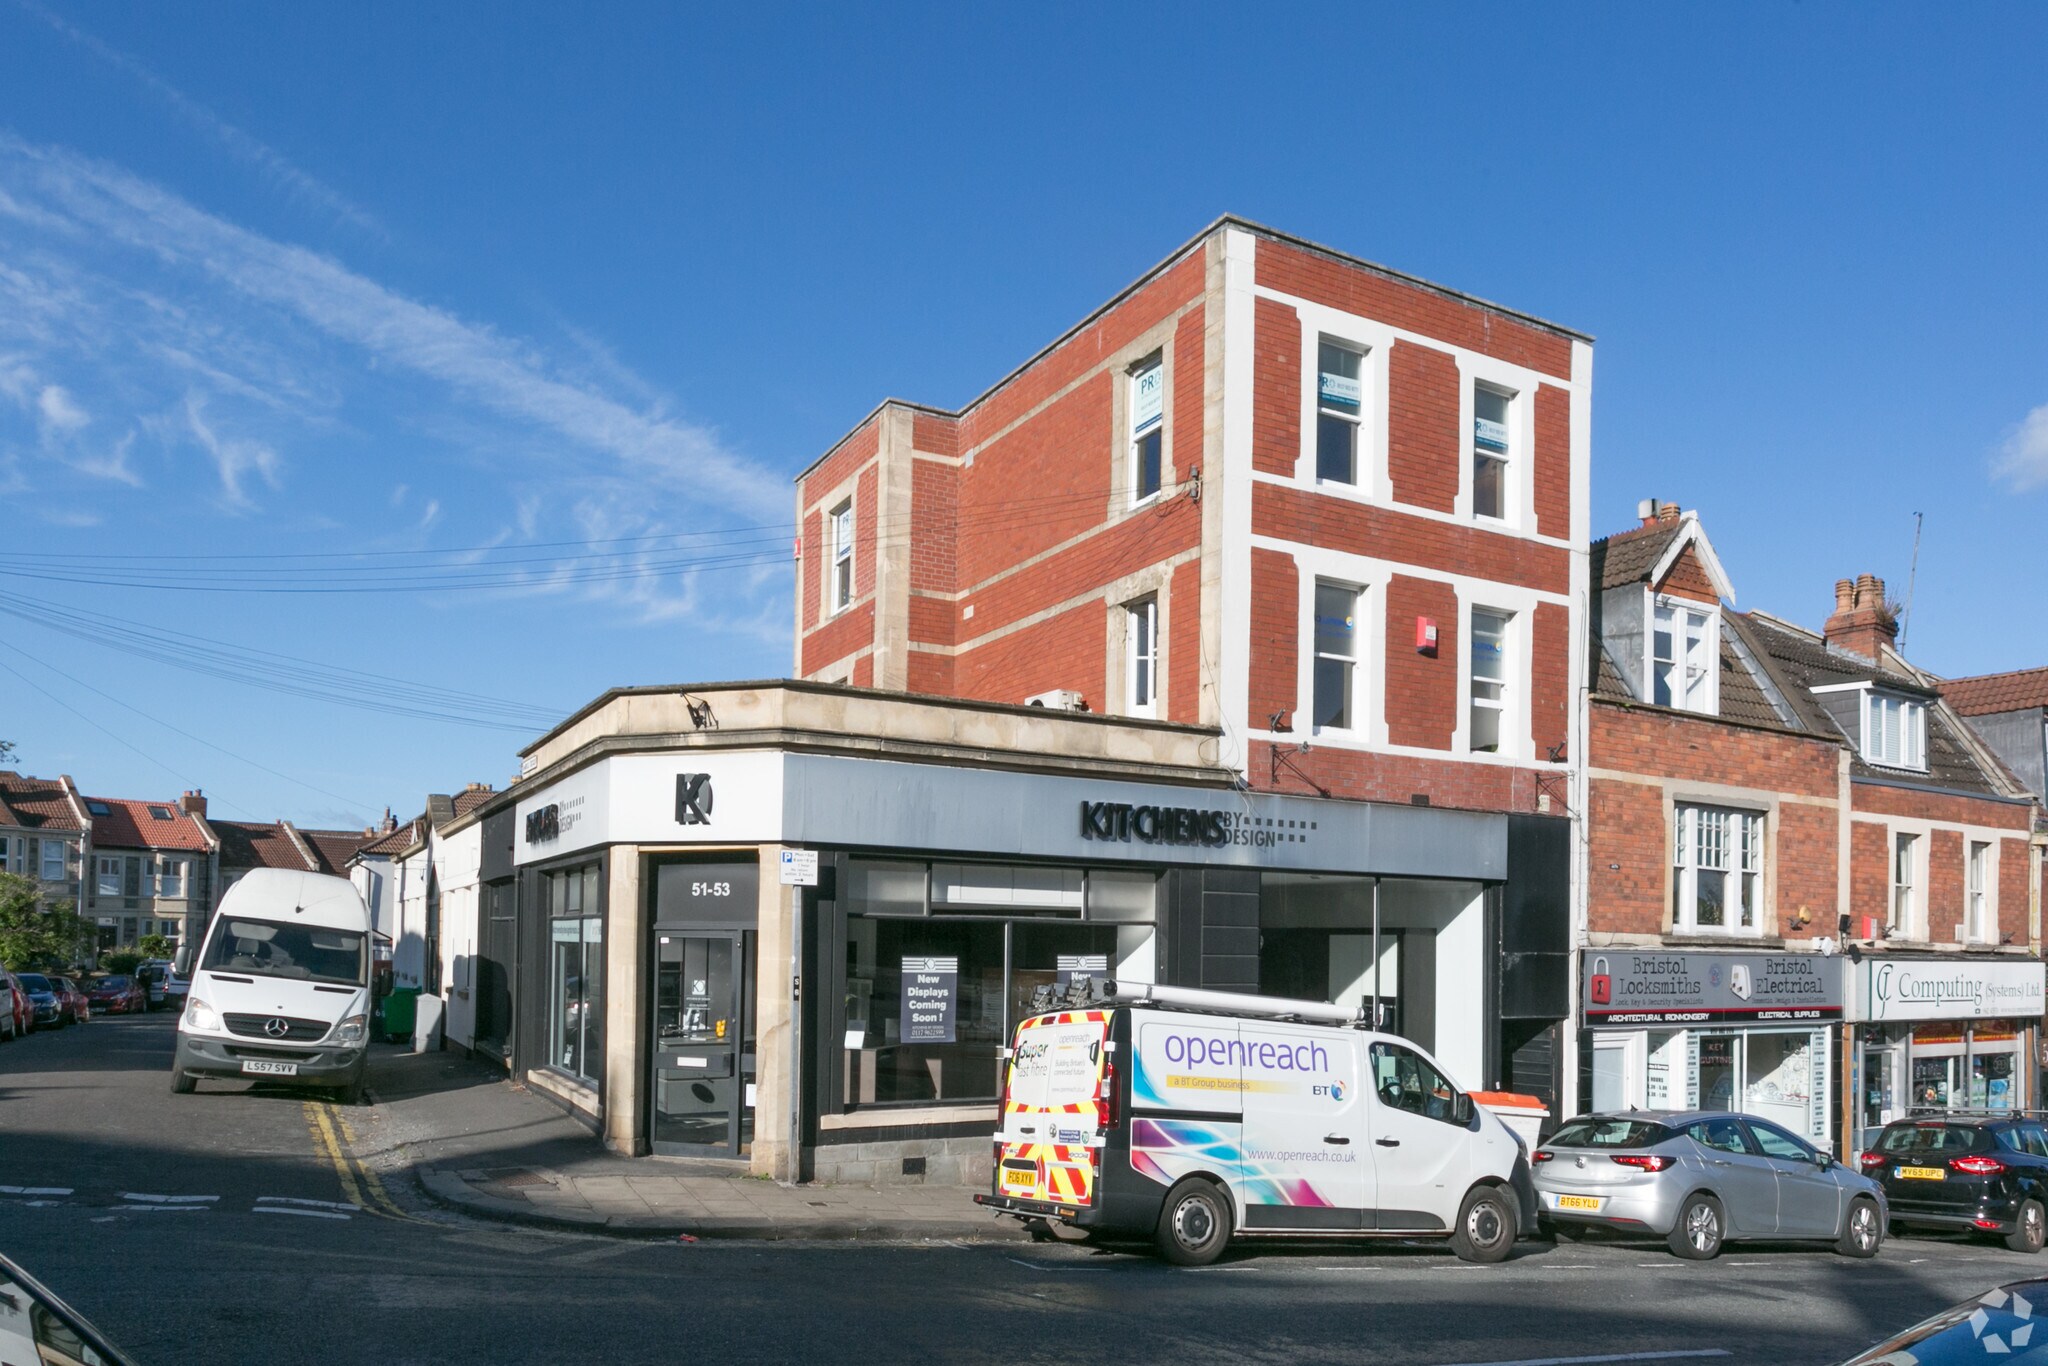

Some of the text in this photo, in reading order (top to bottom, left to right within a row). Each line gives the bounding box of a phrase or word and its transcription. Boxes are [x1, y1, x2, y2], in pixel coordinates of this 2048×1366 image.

[1080, 800, 1226, 847] KITCHENS
[1223, 811, 1243, 828] BY
[1223, 828, 1275, 847] DESIGN
[692, 882, 730, 896] 51-53
[1633, 957, 1688, 974] Bristol
[1766, 958, 1813, 975] Bristol
[917, 974, 940, 984] New
[1618, 977, 1701, 995] Locksmiths
[1756, 978, 1824, 994] Electrical
[907, 987, 949, 998] Displays
[1898, 973, 1983, 1006] Computing
[1985, 982, 2024, 1002] (Systems)
[908, 1000, 947, 1011] Coming
[912, 1013, 937, 1022] Soon
[1607, 1013, 1710, 1022] ARCHITECTURAL IRONMONGERY
[1758, 1010, 1820, 1019] ELECTRICAL SUPPLIES
[1019, 1040, 1049, 1061] Super
[1165, 1035, 1329, 1072] openreach
[1708, 1043, 1724, 1051] KEY
[247, 1062, 273, 1071] LS57
[1181, 1078, 1190, 1086] BT
[1191, 1078, 1216, 1089] Group
[1218, 1079, 1250, 1090] business
[1312, 1085, 1329, 1096] BT
[1248, 1149, 1356, 1163] www.openreach.co.uk
[1560, 1196, 1599, 1208] BT66 YLU
